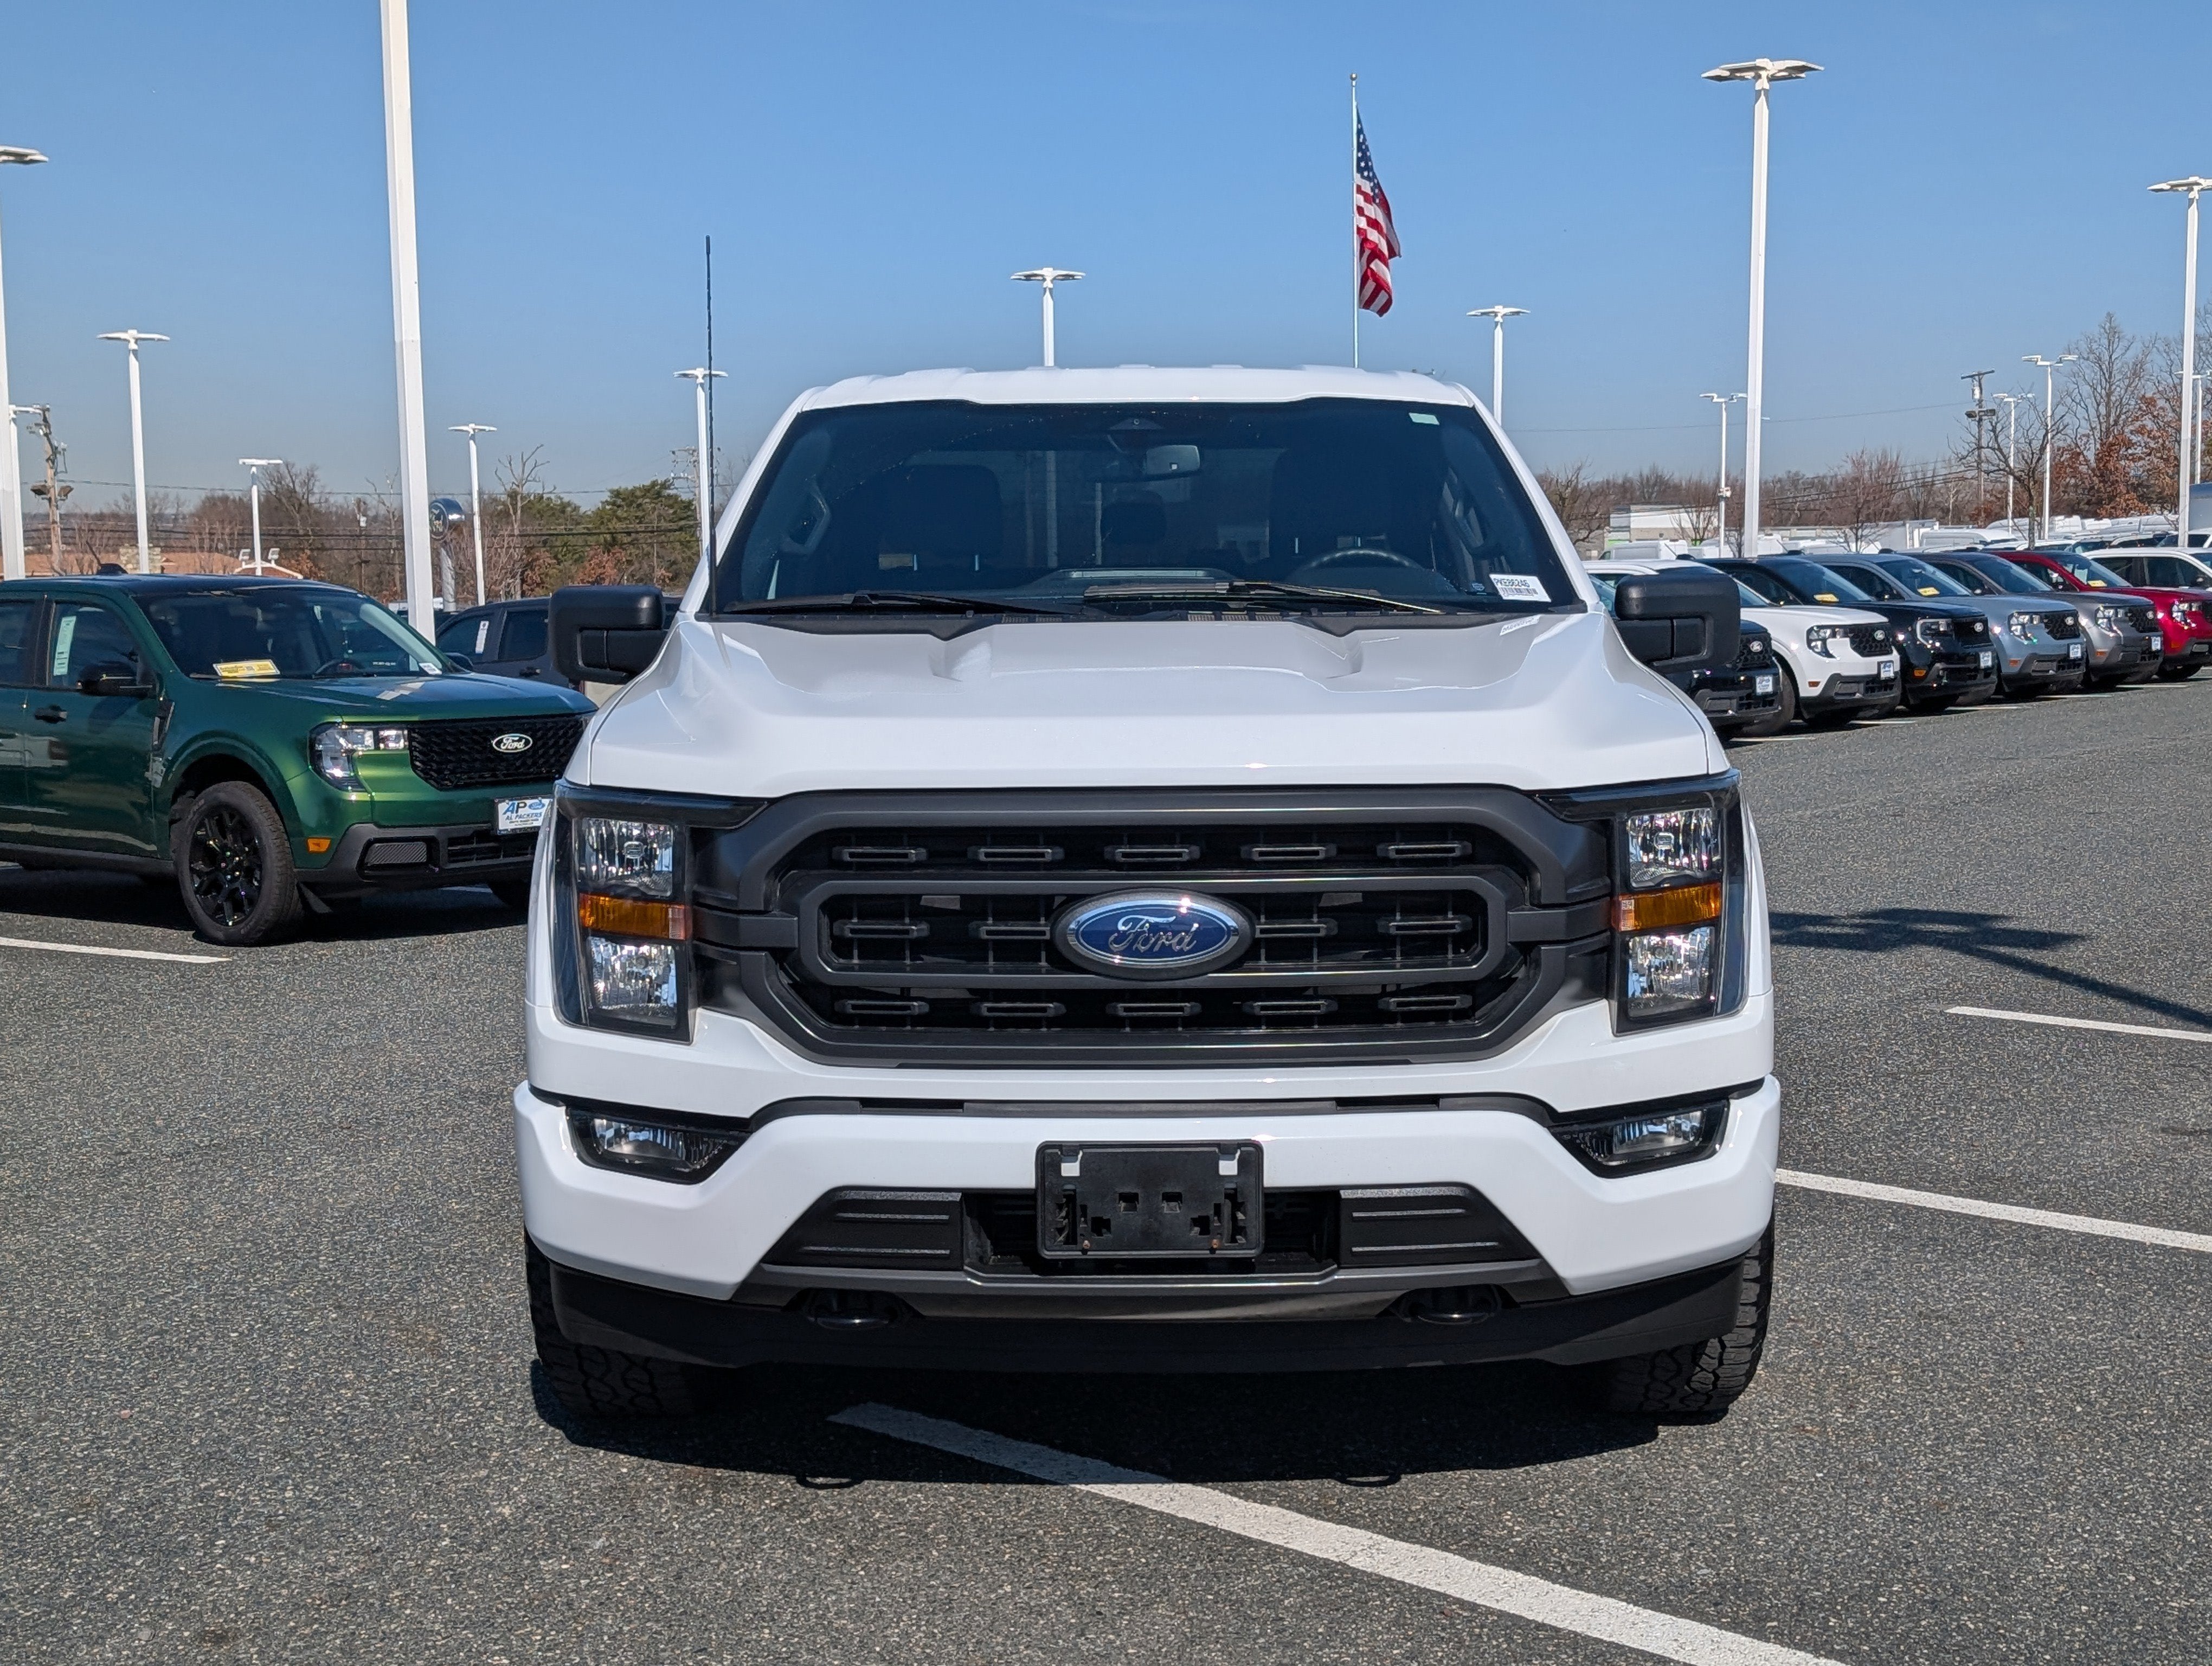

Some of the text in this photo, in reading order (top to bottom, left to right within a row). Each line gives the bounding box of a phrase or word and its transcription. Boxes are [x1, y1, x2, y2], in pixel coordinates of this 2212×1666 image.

[500, 737, 525, 749] Ford
[503, 802, 527, 815] AP
[1109, 915, 1199, 953] Ford
